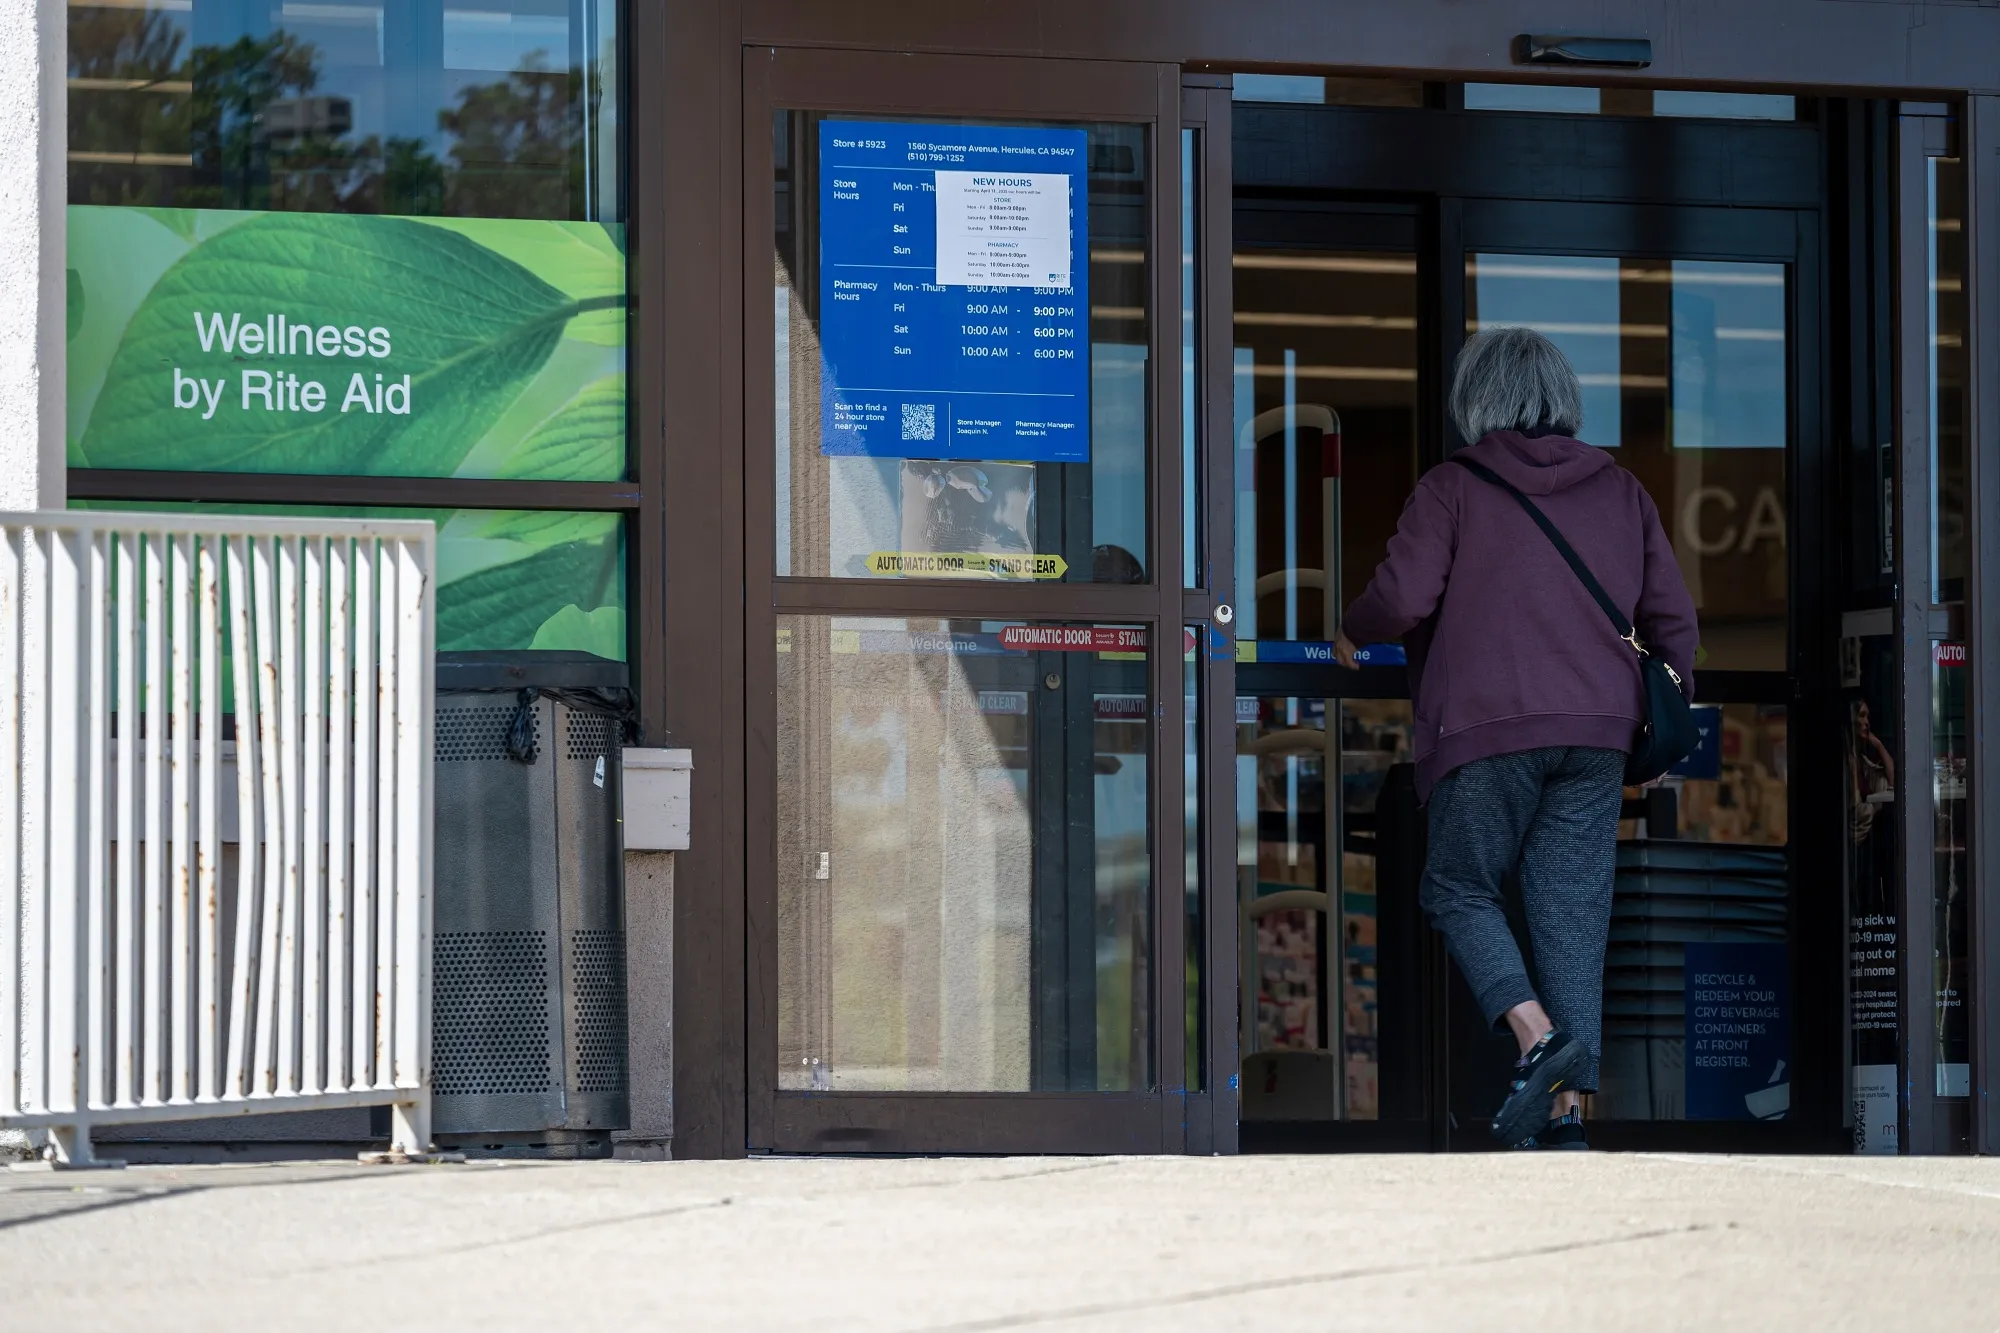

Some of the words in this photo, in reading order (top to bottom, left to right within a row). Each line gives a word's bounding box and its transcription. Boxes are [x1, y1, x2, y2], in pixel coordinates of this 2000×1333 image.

[833, 139, 856, 148] Store
[865, 140, 886, 149] 5923
[907, 142, 927, 150] 1560
[928, 143, 967, 153] Sycamore
[968, 144, 1000, 153] Avenue,
[1001, 146, 1036, 155] Hercules,
[1038, 147, 1050, 155] CA
[1050, 147, 1075, 156] 94547
[907, 152, 928, 162] (510)
[928, 153, 965, 162] 799-1252
[833, 179, 857, 188] Store
[893, 182, 913, 191] Mon
[973, 177, 996, 186] NEW
[998, 178, 1032, 187] HOURS
[833, 191, 860, 200] Hours
[893, 203, 904, 212] Fri
[893, 224, 908, 233] Sat
[893, 246, 911, 254] Sun
[834, 280, 878, 291] Pharmacy
[893, 282, 913, 291] Mon
[921, 283, 947, 292] Thurs
[966, 285, 988, 294] 9:00
[990, 285, 1008, 294] AM
[1033, 286, 1055, 295] 9:00
[1057, 286, 1074, 296] PM
[834, 292, 860, 301] Hours
[893, 304, 905, 313] Fri
[966, 304, 988, 314] 9:00
[990, 305, 1008, 315] AM
[1033, 306, 1055, 316] 9:00
[1057, 307, 1074, 317] PM
[193, 311, 391, 358] Wellness
[893, 325, 908, 334] Sat
[961, 325, 989, 335] 10:00
[990, 326, 1008, 336] AM
[1033, 328, 1055, 338] 6:00
[1057, 328, 1074, 338] PM
[893, 346, 912, 355] Sun
[961, 346, 989, 357] 10:00
[990, 347, 1008, 357] AM
[1033, 349, 1055, 359] 6:00
[1057, 349, 1074, 359] PM
[173, 367, 226, 420] by
[241, 369, 327, 412] Rite
[340, 372, 411, 415] Aid
[834, 403, 853, 411] Scan
[855, 403, 863, 411] to
[865, 403, 880, 411] find
[834, 412, 844, 420] 24
[865, 413, 885, 421] store
[853, 423, 868, 431] you
[1015, 420, 1046, 428] Pharmacy
[957, 427, 981, 435] Joaquin
[876, 556, 934, 571] AUTOMATIC
[937, 557, 964, 572] DOOR
[989, 558, 1021, 573] STAND
[1024, 559, 1056, 574] CLEAR
[1004, 628, 1062, 644] AUTOMATIC
[1064, 629, 1092, 645] DOOR
[1119, 630, 1146, 646] STAN
[909, 637, 977, 651] Welcome
[1304, 647, 1371, 661] Welme
[1937, 645, 1965, 661] AUTO
[988, 696, 1017, 709] CLEAR
[1864, 914, 1884, 925] sick
[1873, 932, 1896, 945] may
[1866, 948, 1882, 959] out
[1864, 967, 1895, 977] mome
[1694, 973, 1745, 985] RECYCLE
[1747, 974, 1756, 985] &
[1694, 990, 1740, 1002] REDEEM
[1743, 990, 1775, 1002] YOUR
[1935, 999, 1960, 1008] pared
[1694, 1006, 1718, 1018] CRV
[1720, 1006, 1780, 1018] BEVERAGE
[1694, 1023, 1767, 1035] CONTAINERS
[1695, 1039, 1708, 1051] AT
[1711, 1039, 1749, 1051] FRONT
[1695, 1055, 1751, 1068] REGISTER.
